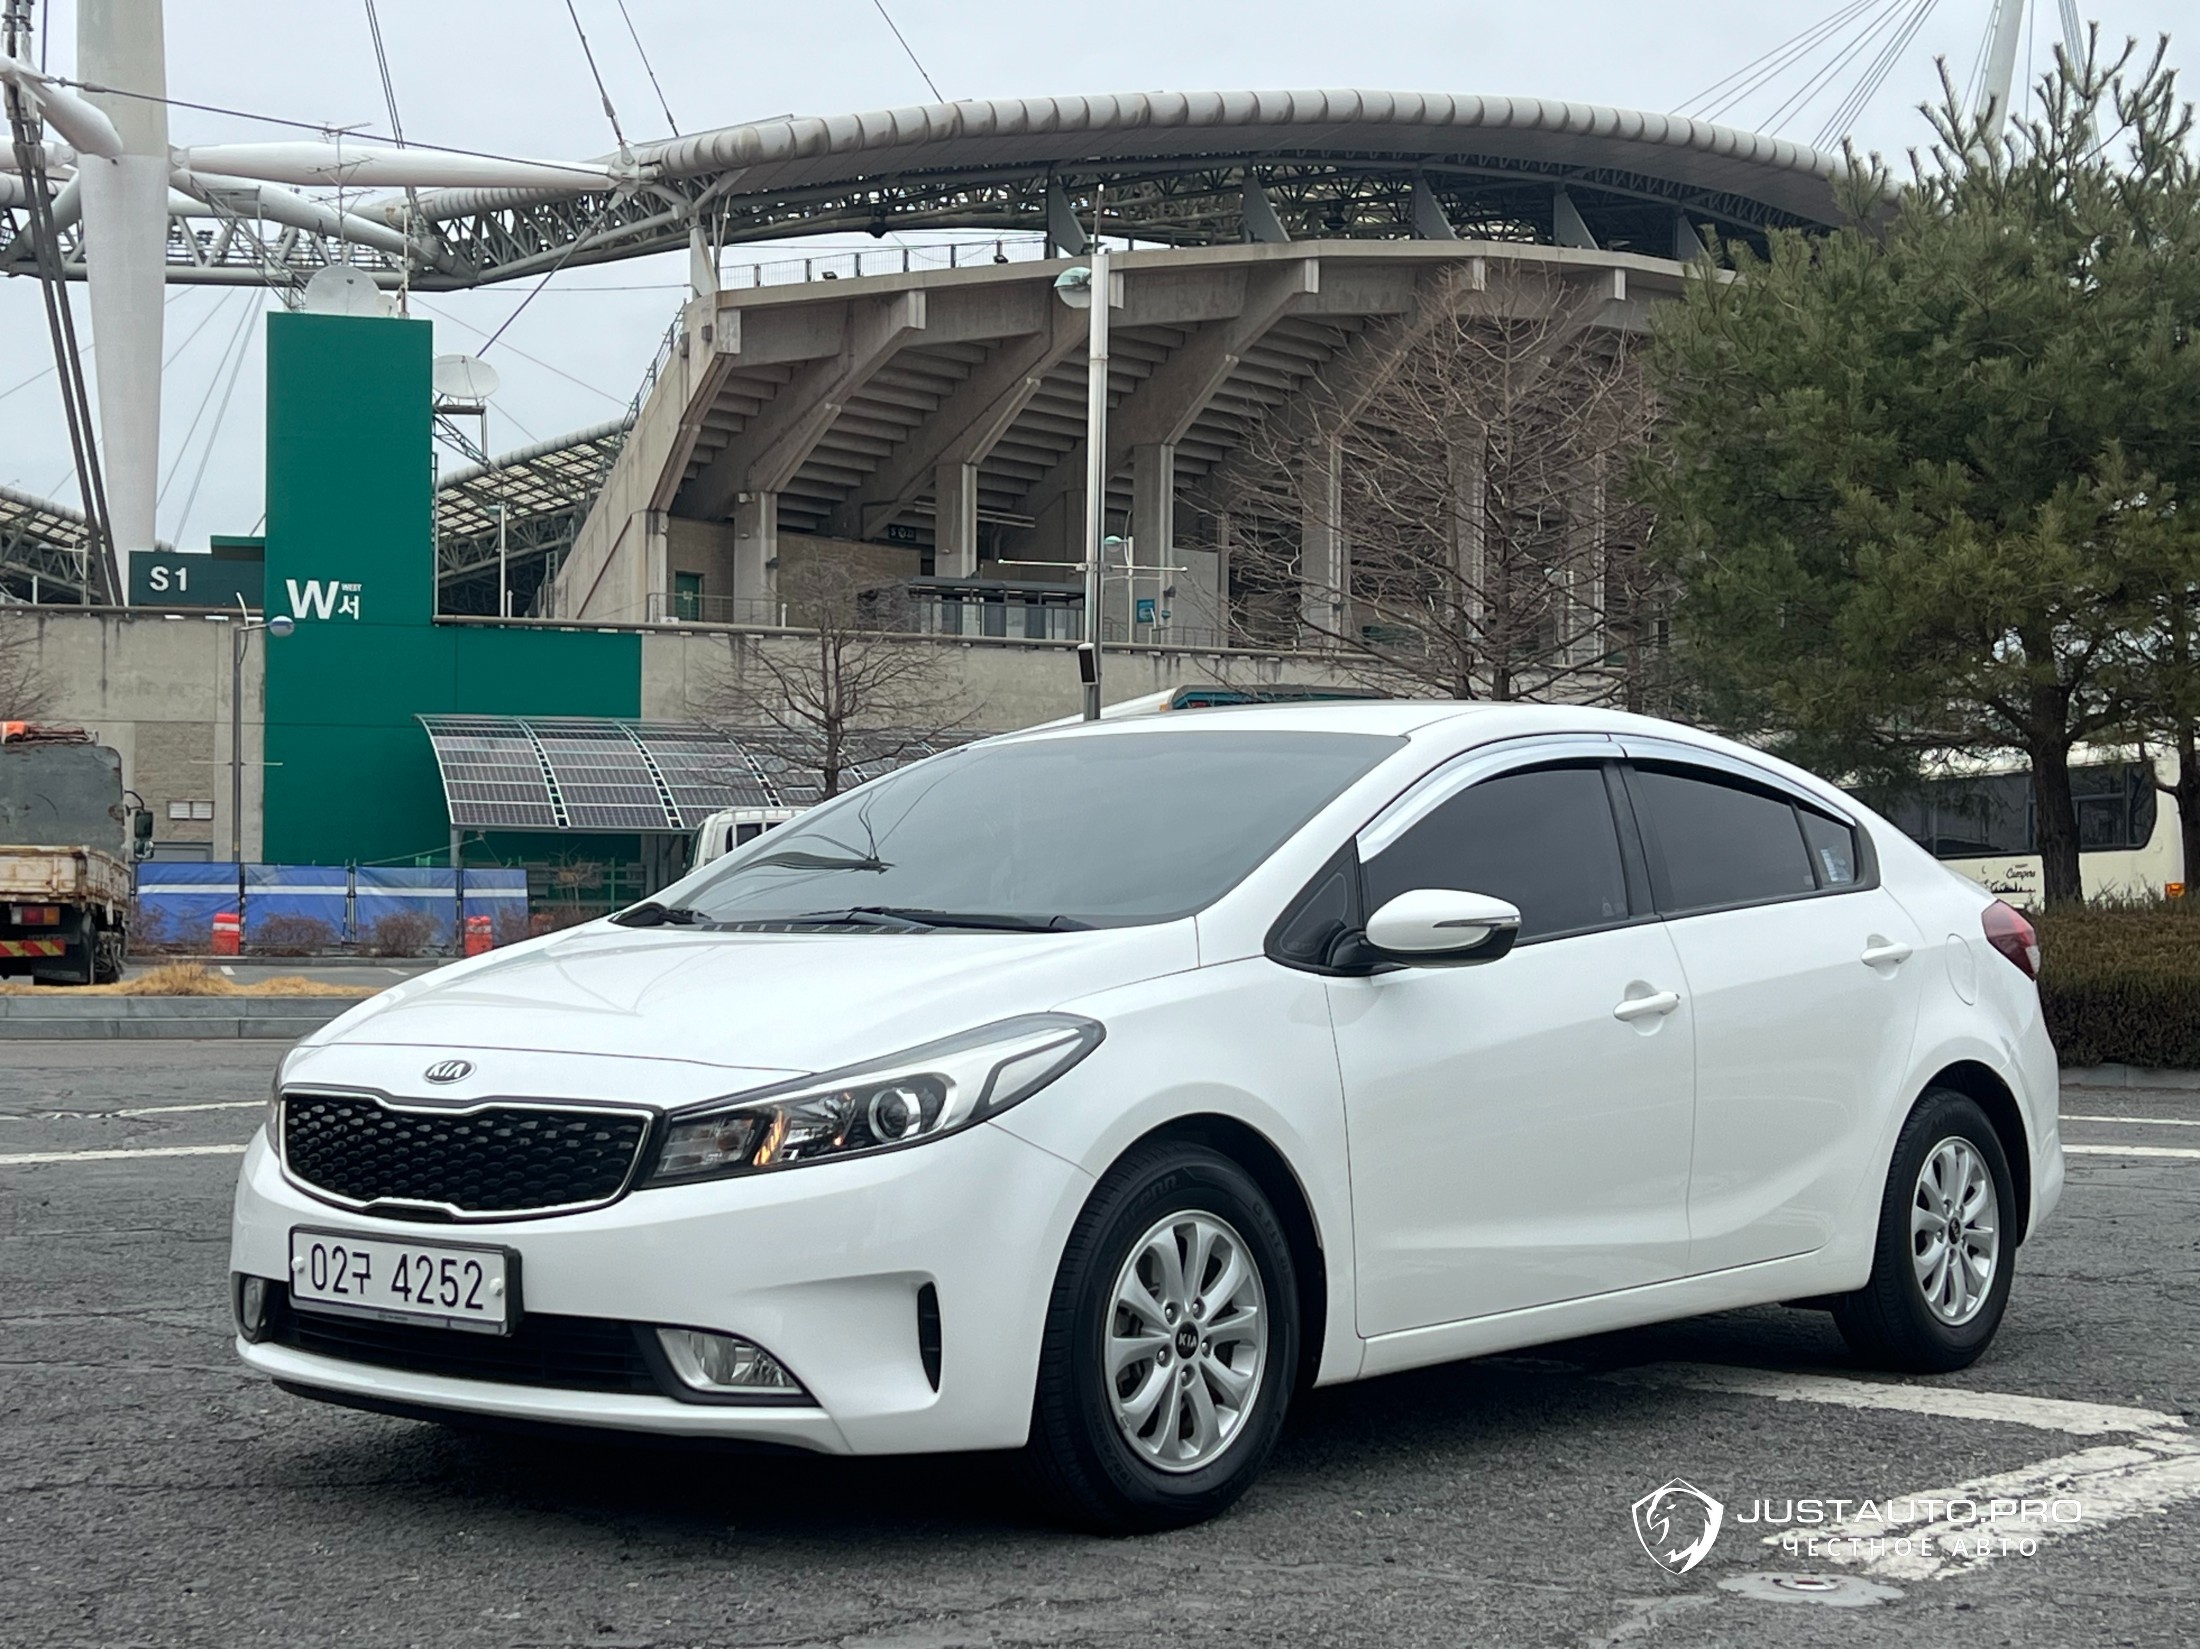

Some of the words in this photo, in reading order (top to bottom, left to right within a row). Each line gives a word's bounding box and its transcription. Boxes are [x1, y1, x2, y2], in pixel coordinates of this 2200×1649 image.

[285, 579, 340, 619] W
[338, 595, 359, 620] 서
[427, 1061, 466, 1078] KIA
[311, 1242, 371, 1295] 02구
[391, 1253, 484, 1310] 4252
[1179, 1332, 1197, 1348] KIA
